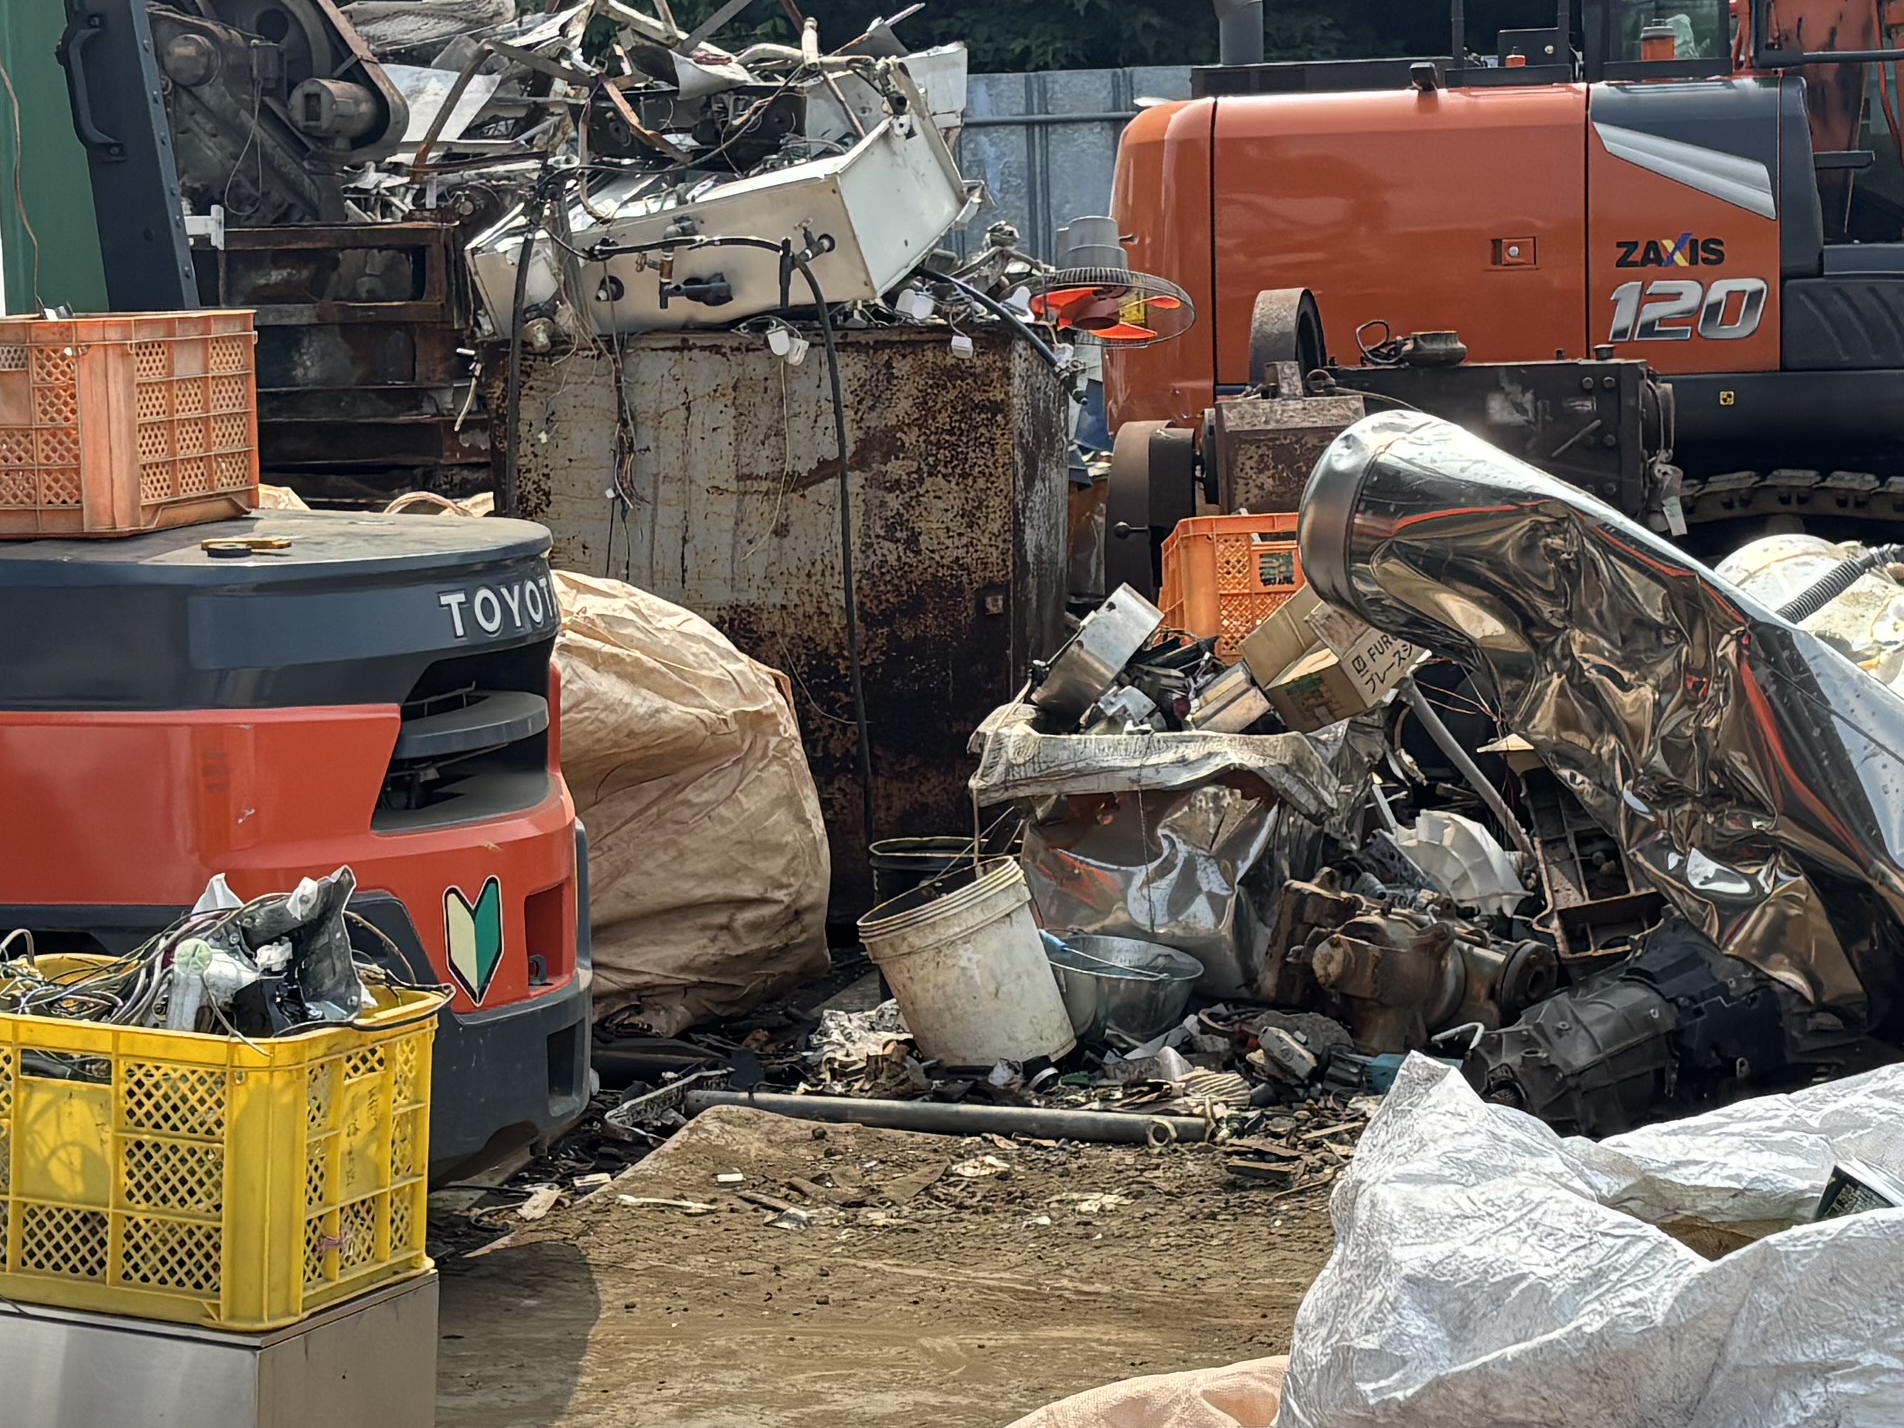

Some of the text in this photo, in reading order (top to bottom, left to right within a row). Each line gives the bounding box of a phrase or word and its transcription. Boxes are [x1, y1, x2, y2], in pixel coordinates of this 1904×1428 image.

[1615, 232, 1726, 269] ZAXIS
[1608, 277, 1769, 343] 120
[1367, 634, 1399, 663] FUR
